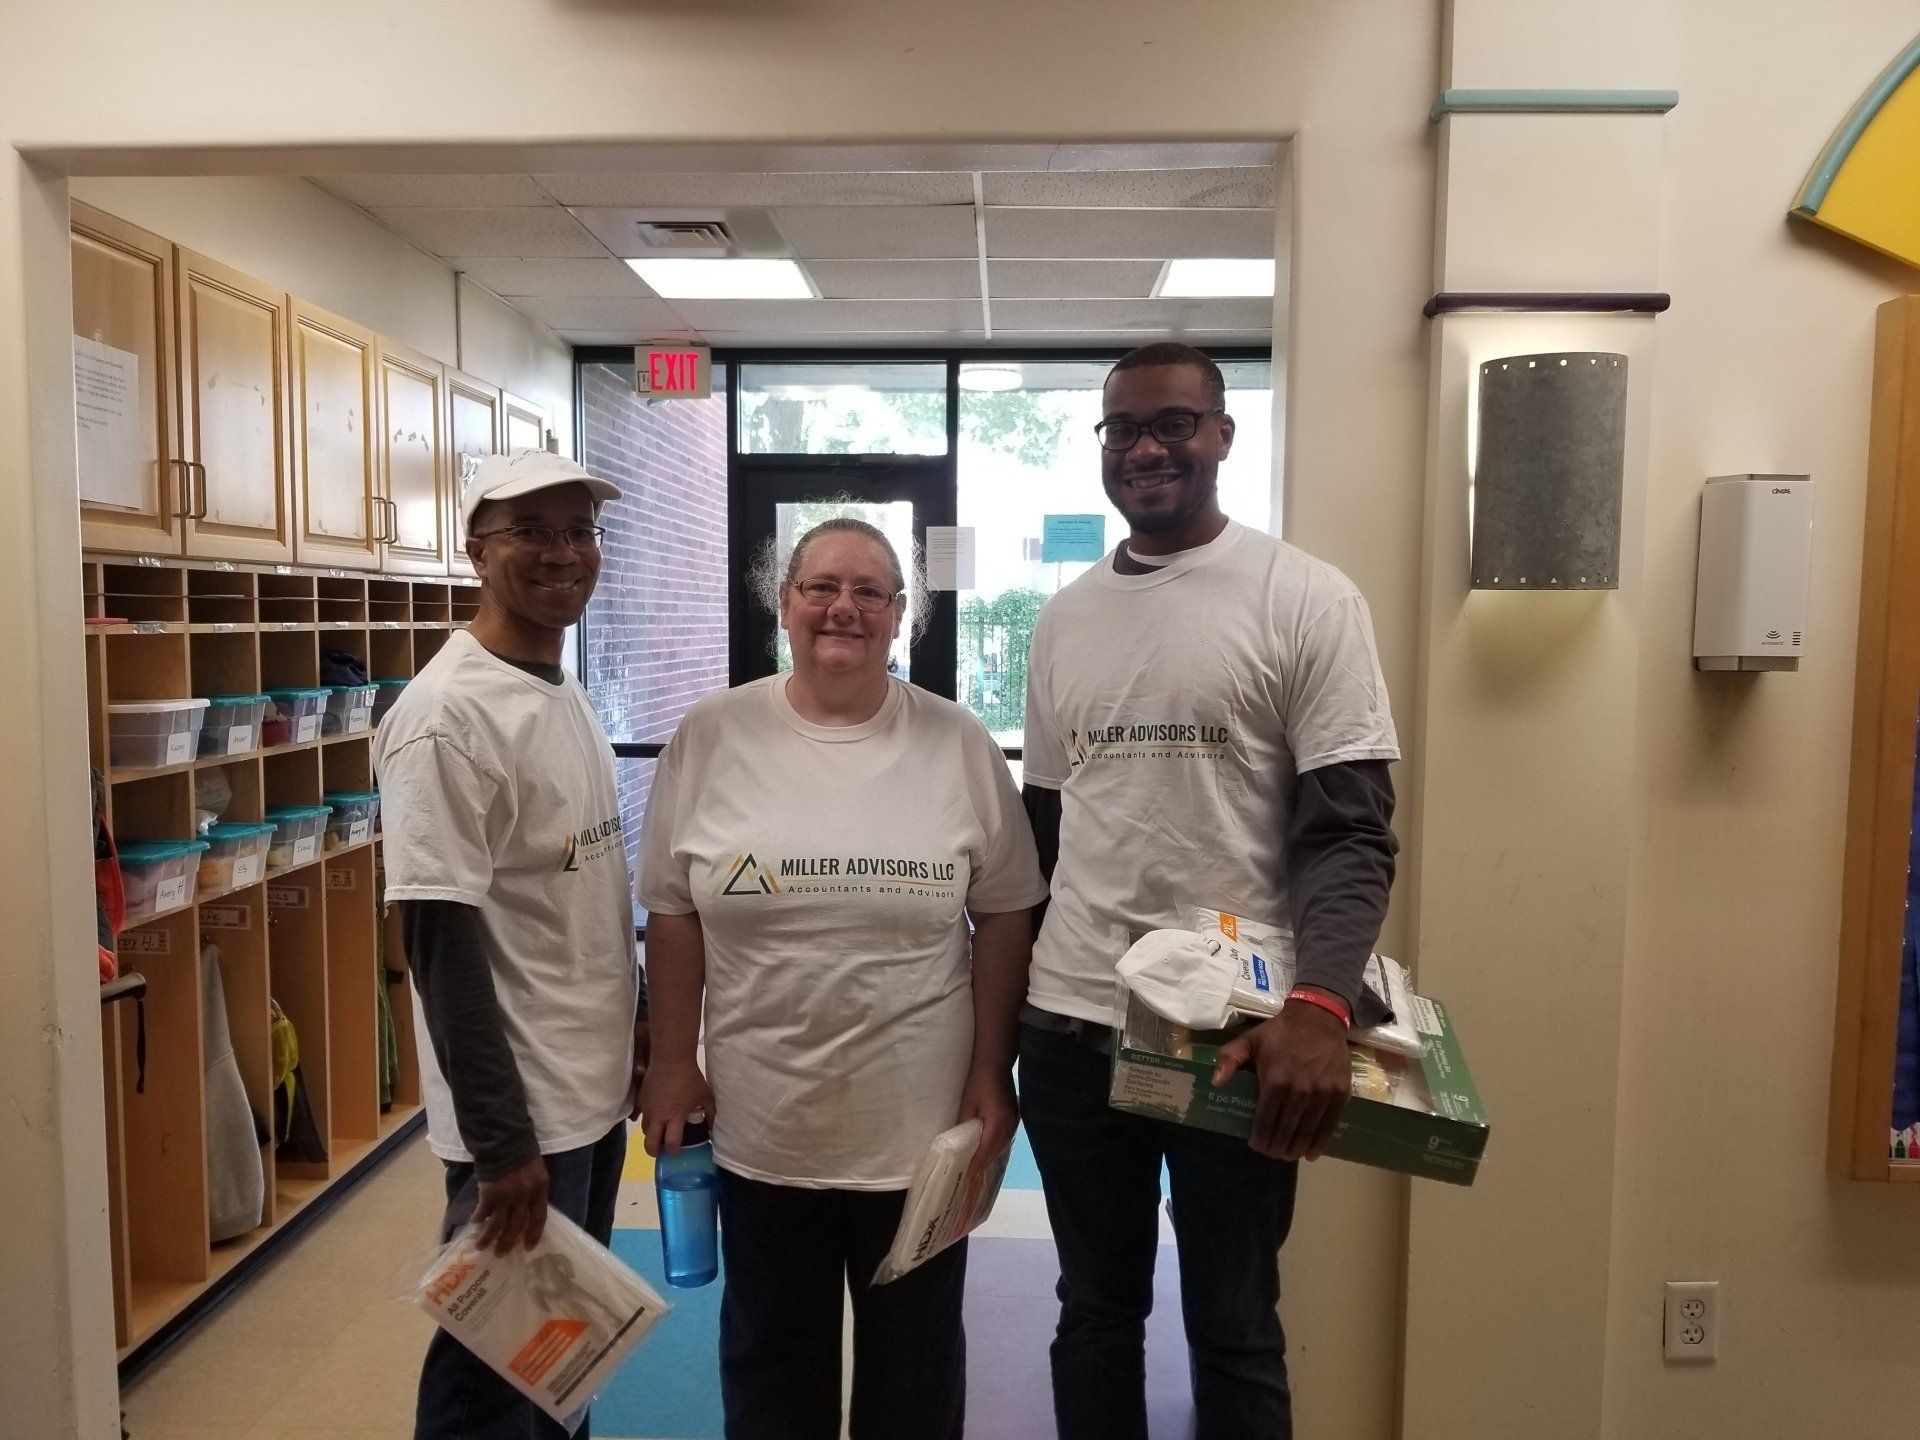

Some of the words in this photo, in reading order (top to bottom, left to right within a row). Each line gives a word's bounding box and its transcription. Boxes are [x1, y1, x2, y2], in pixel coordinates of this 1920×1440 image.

[649, 353, 698, 391] EXIT
[1129, 724, 1196, 743] ADVISORS
[1201, 725, 1228, 744] LLC
[1151, 750, 1171, 758] and
[1177, 751, 1225, 760] Advisors
[780, 858, 840, 877] MILLER
[846, 858, 929, 879] ADVISORS
[932, 862, 955, 881] LLC
[788, 885, 872, 894] Accountants
[879, 885, 901, 894] and
[908, 888, 955, 898] Advisors
[1230, 947, 1239, 960] Duty
[1240, 958, 1251, 981] Coverall
[448, 1302, 460, 1316] All
[457, 1270, 490, 1304] Purpose
[455, 1287, 488, 1322] Coverall
